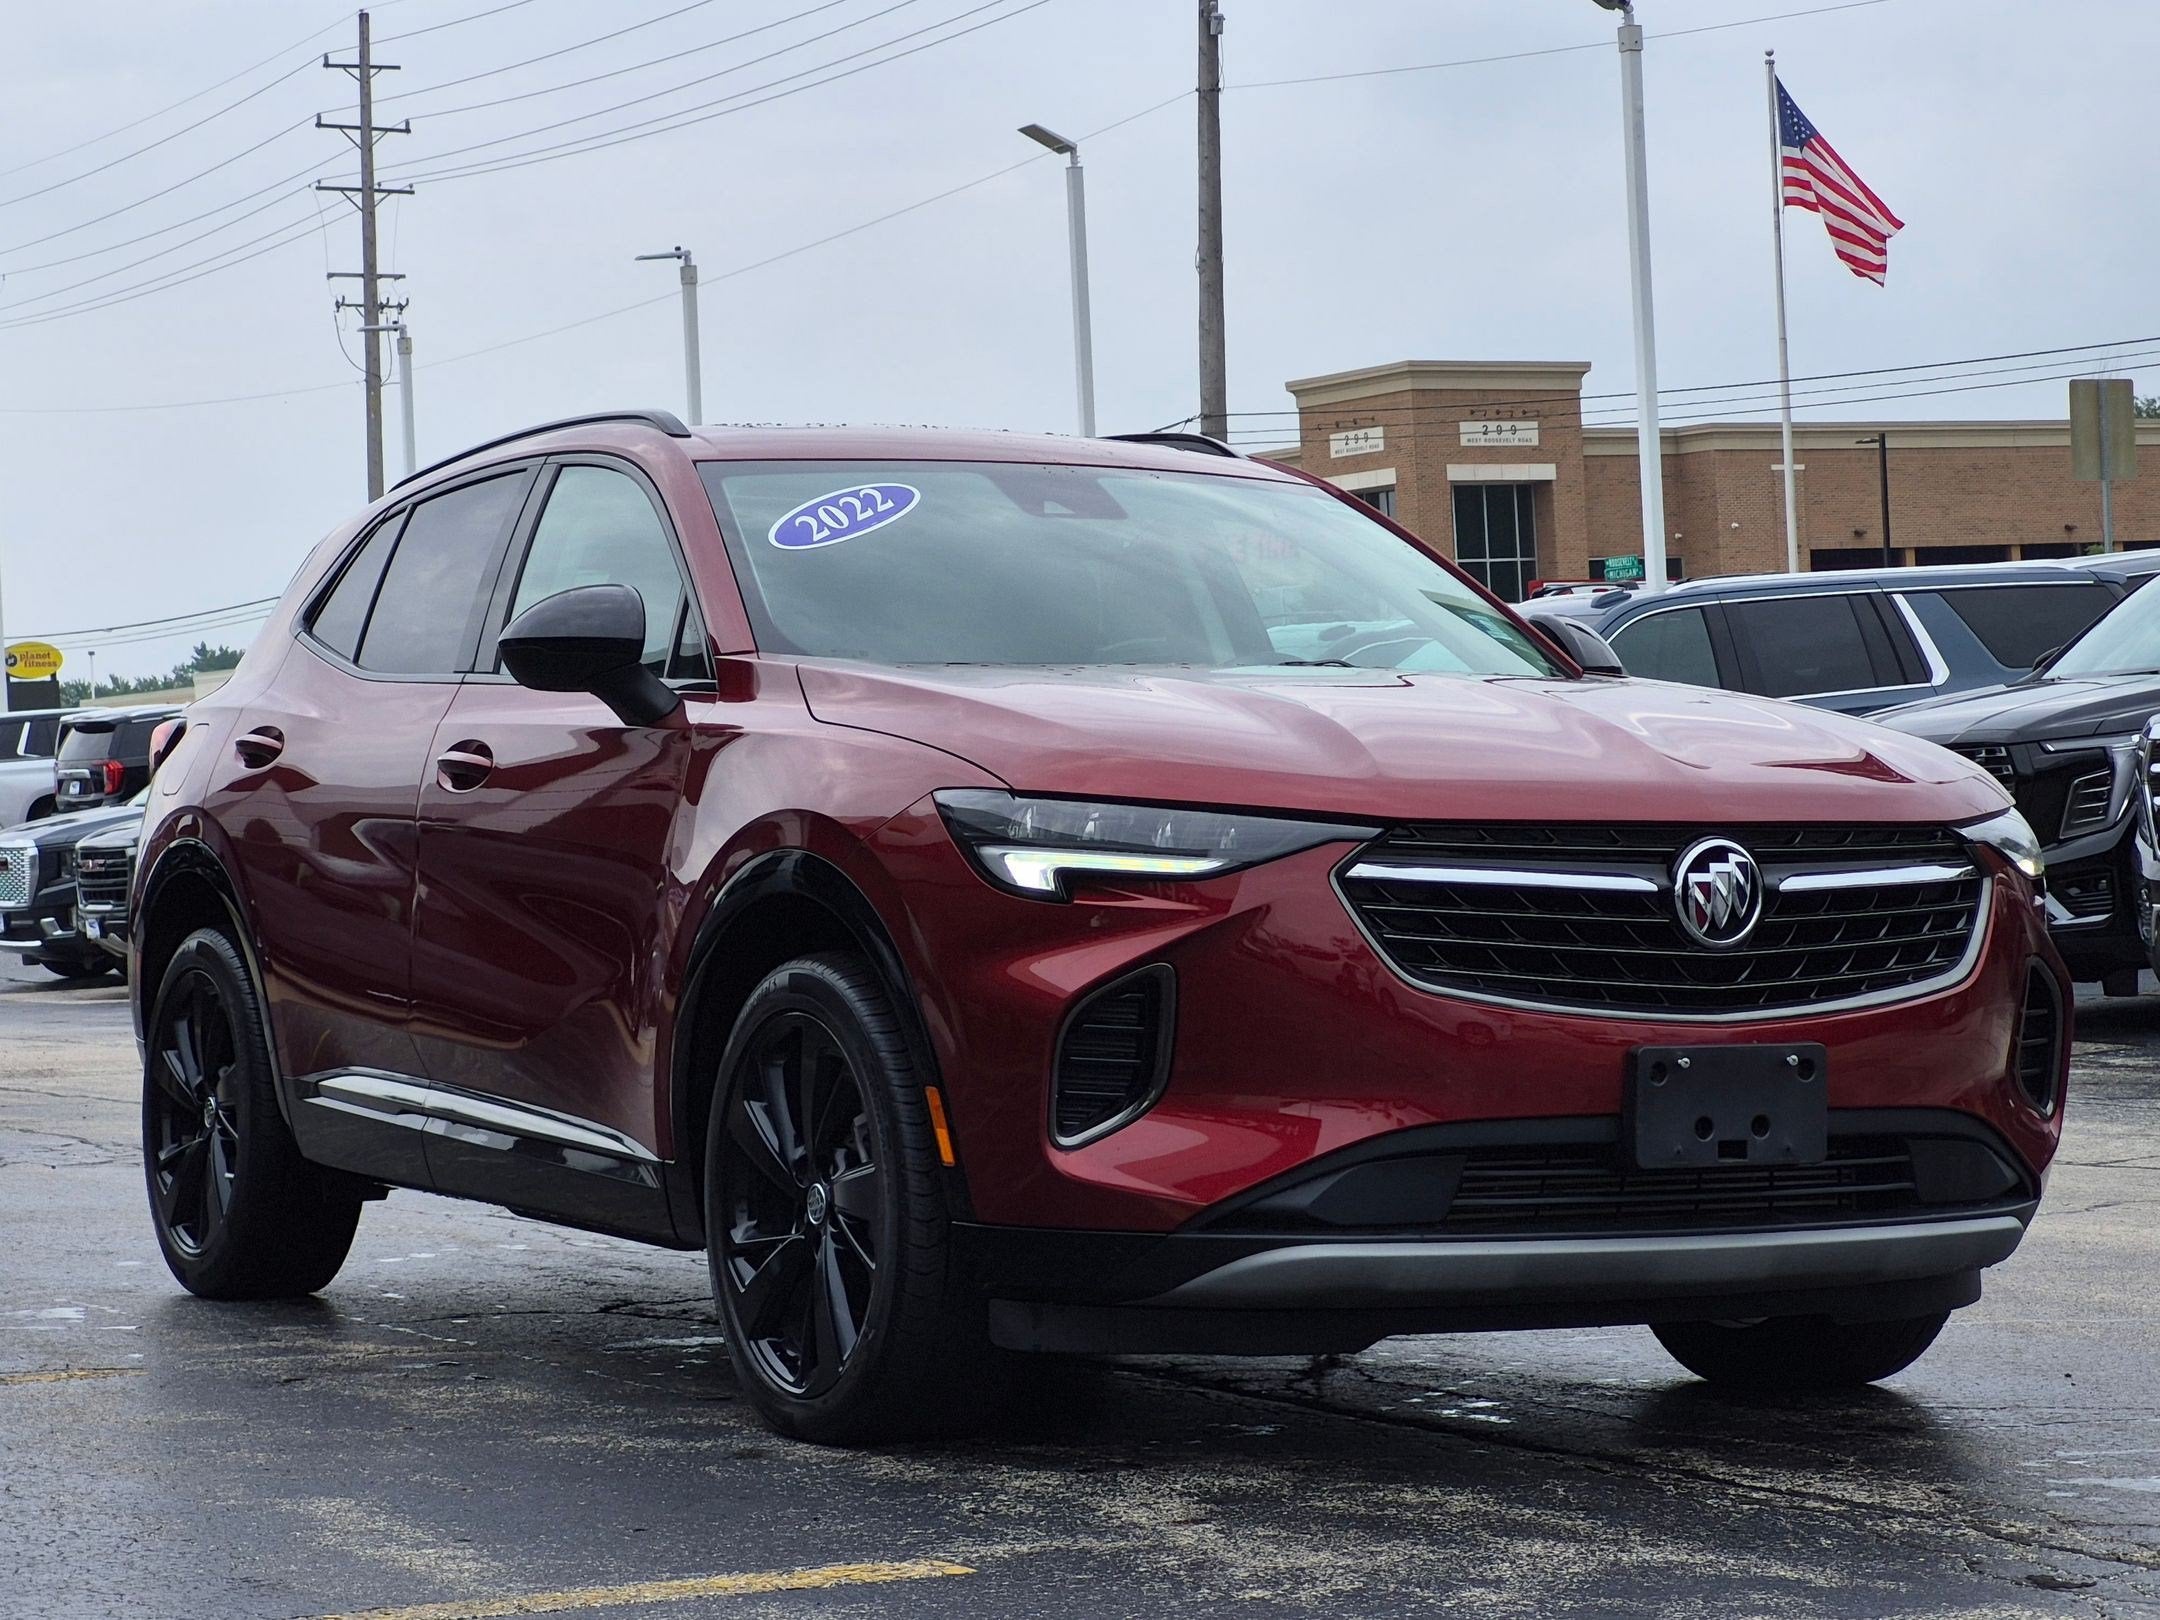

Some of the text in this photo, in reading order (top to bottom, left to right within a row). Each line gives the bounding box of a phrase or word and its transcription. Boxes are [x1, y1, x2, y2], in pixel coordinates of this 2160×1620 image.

[1482, 424, 1517, 436] 299
[1344, 432, 1369, 446] 299
[795, 488, 895, 542] 2022
[20, 651, 51, 662] planet
[24, 660, 58, 668] fitness
